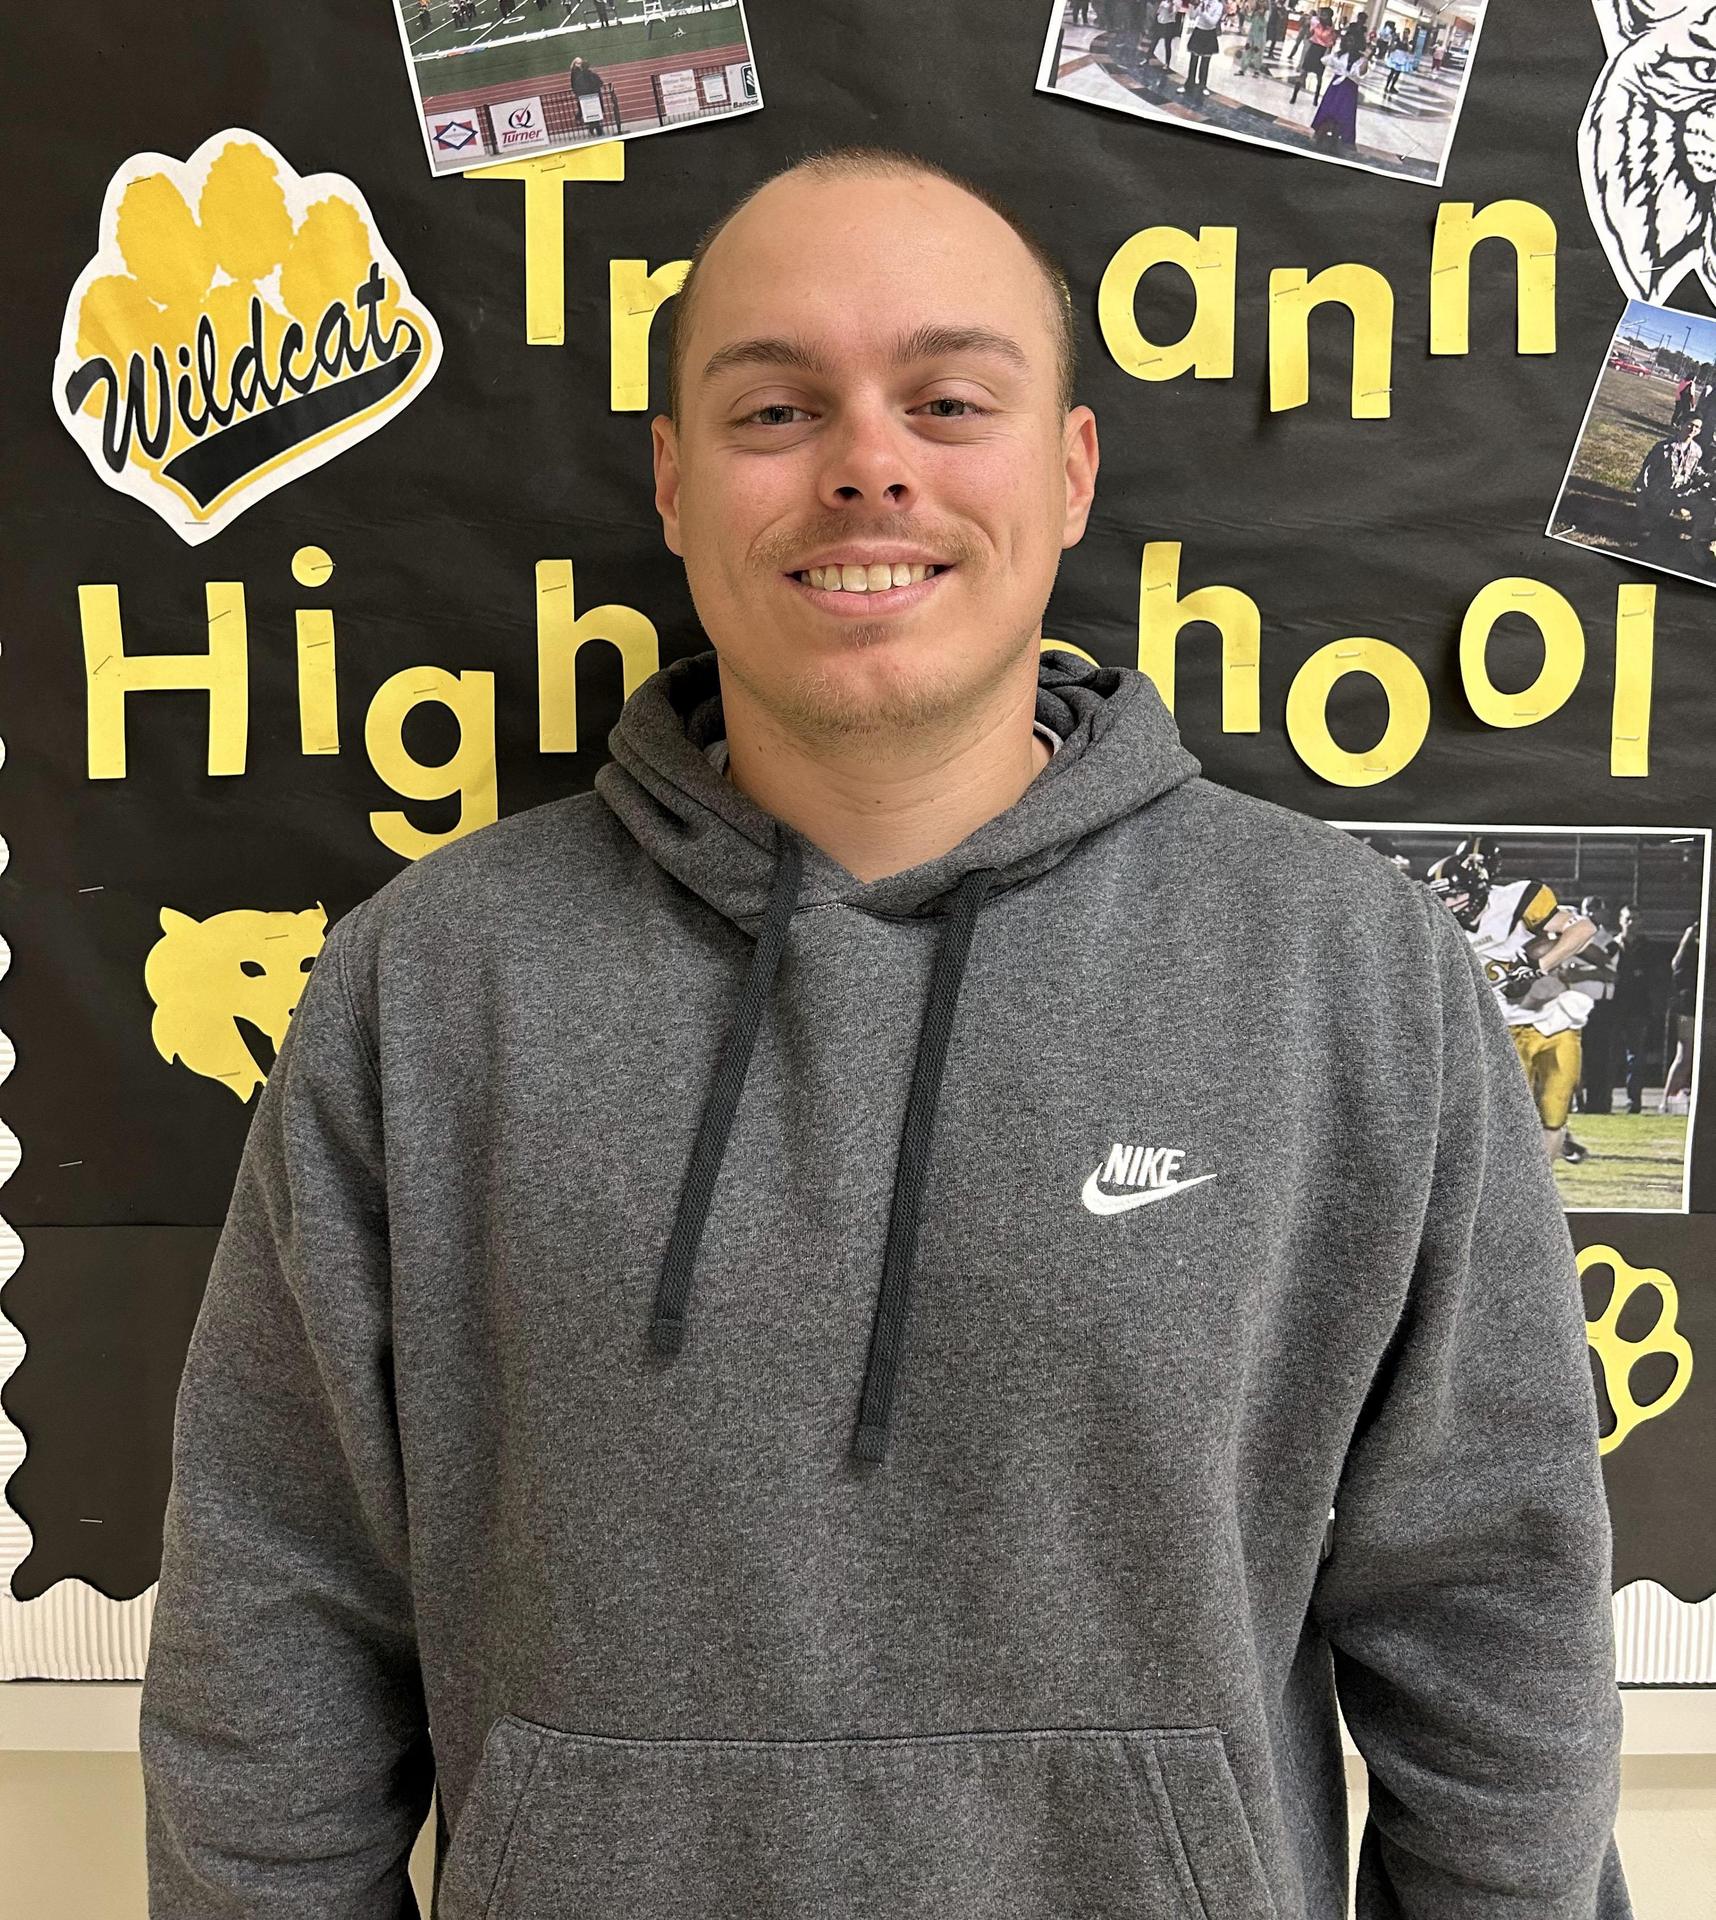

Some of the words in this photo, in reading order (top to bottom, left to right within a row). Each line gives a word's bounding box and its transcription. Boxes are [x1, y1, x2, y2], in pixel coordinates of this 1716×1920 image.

[502, 129, 543, 145] Turner
[64, 261, 408, 473] Wildcat
[463, 141, 1558, 420] Trann
[77, 545, 661, 861] High
[1040, 541, 1657, 788] hool
[1100, 1143, 1186, 1188] NIKE
